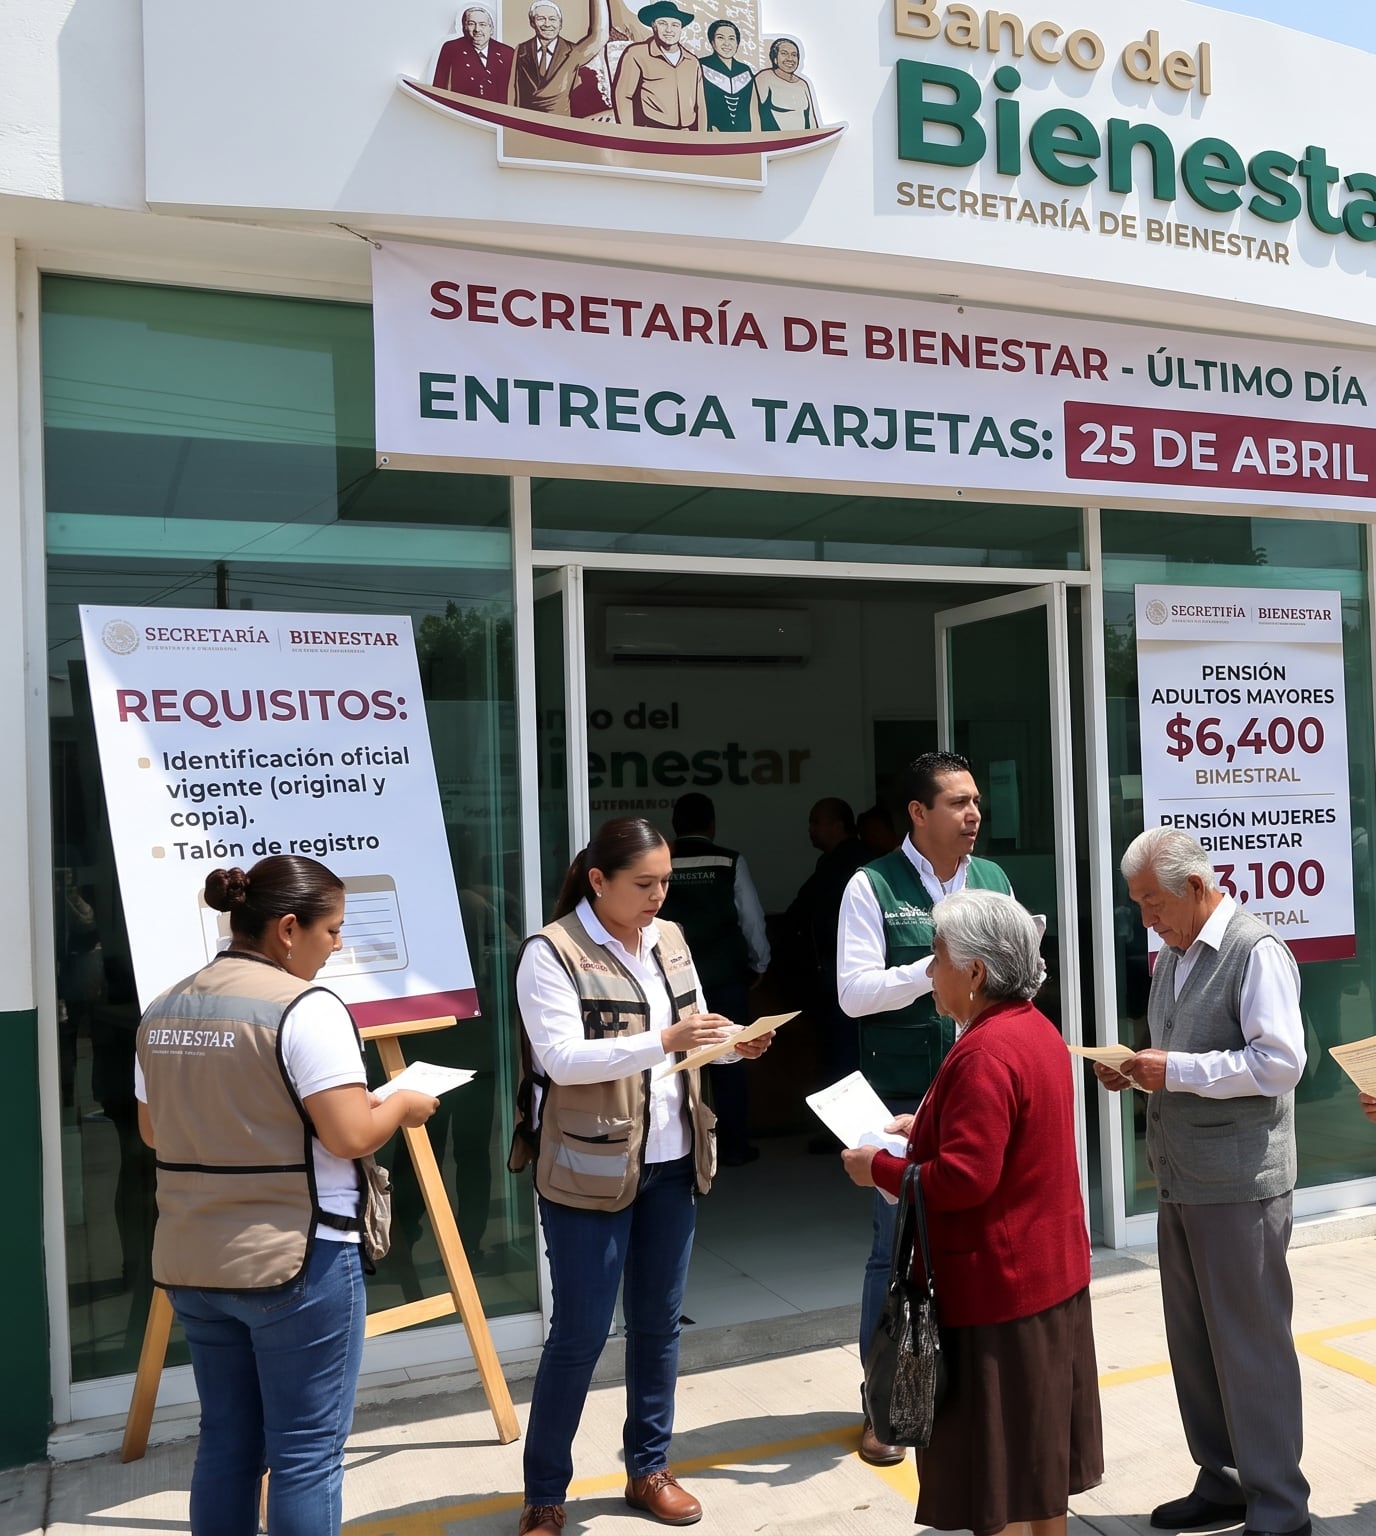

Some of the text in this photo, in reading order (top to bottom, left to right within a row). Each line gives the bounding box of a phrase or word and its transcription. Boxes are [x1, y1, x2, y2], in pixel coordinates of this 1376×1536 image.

[894, 0, 1211, 95] Banco del
[896, 181, 1290, 265] SECRETARÍA DE BIENESTAR
[430, 281, 768, 349] SECRETARÍA
[784, 316, 848, 356] DE
[865, 325, 1109, 381] BIENESTAR
[1148, 347, 1293, 399] ÚLTIMO
[1305, 366, 1368, 407] DÍA
[419, 372, 1369, 482] ENTREGA TARJETAS: 25 DE ABRIL
[1258, 607, 1332, 621] BIENESTAR
[145, 626, 399, 646] SECRETARÍA BIENESTAR
[1202, 662, 1286, 681] PENSIÓN
[116, 689, 408, 728] REQUISITOS:
[1151, 688, 1335, 705] ADULTOS MAYORES
[1166, 712, 1324, 763] $6,400
[163, 746, 410, 771] Identificación oficial
[166, 773, 386, 803] vigente (original y
[1195, 767, 1301, 785] BIMESTRAL
[170, 805, 255, 831] copia).
[1160, 808, 1336, 829] PENSIÓN MUJERES
[173, 833, 380, 860] Talón de registro
[1200, 832, 1303, 852] BIENESTAR
[1213, 859, 1325, 905] 3,100
[147, 1029, 235, 1048] BIENESTAR
